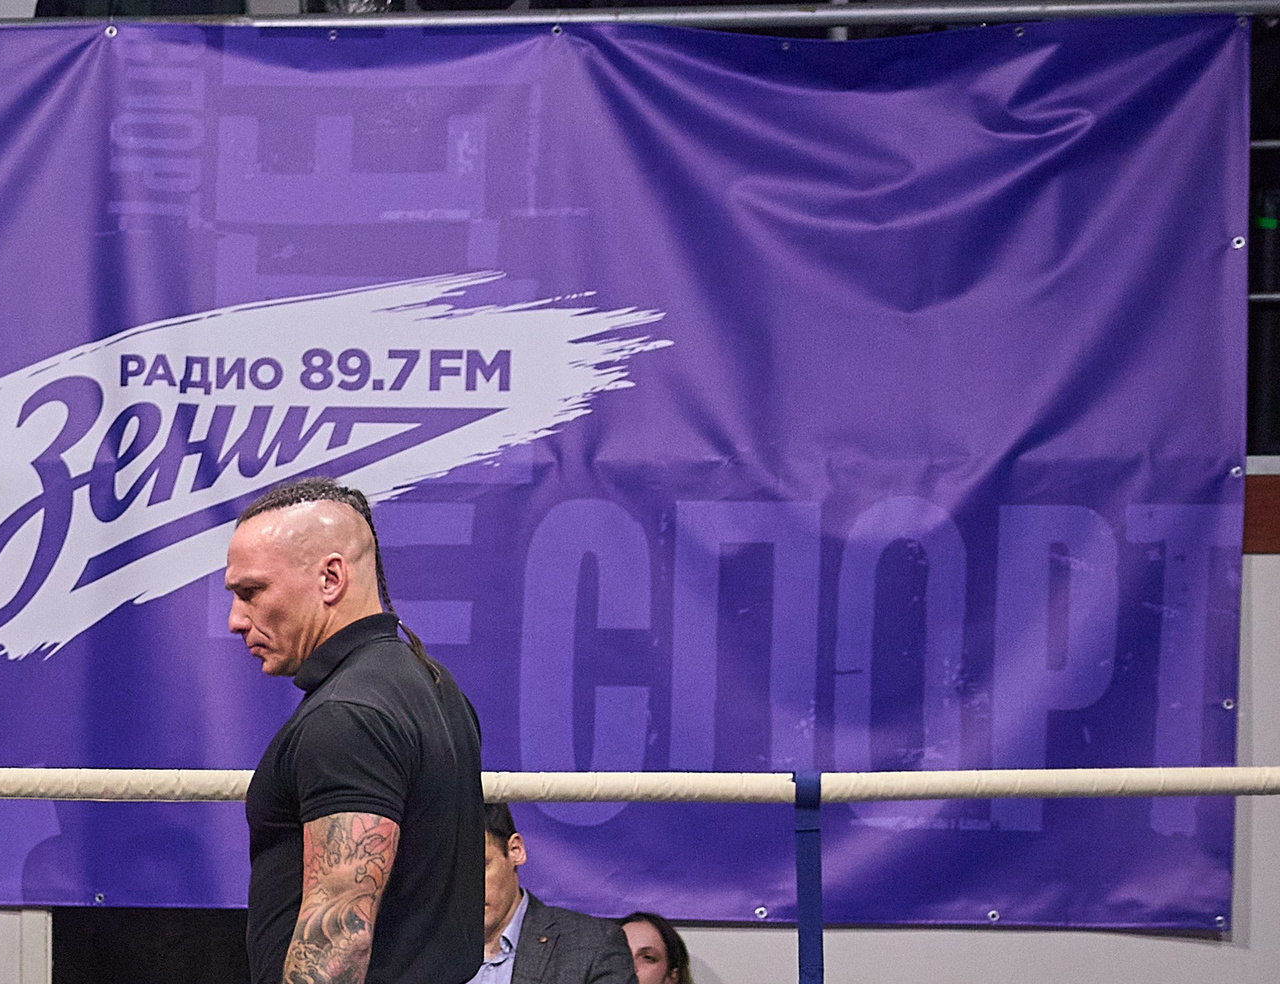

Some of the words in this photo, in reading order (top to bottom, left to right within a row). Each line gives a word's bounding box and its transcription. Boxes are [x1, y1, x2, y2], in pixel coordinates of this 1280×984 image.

[120, 353, 283, 394] РАДИО
[300, 348, 421, 392] 89.7
[429, 349, 511, 391] FM
